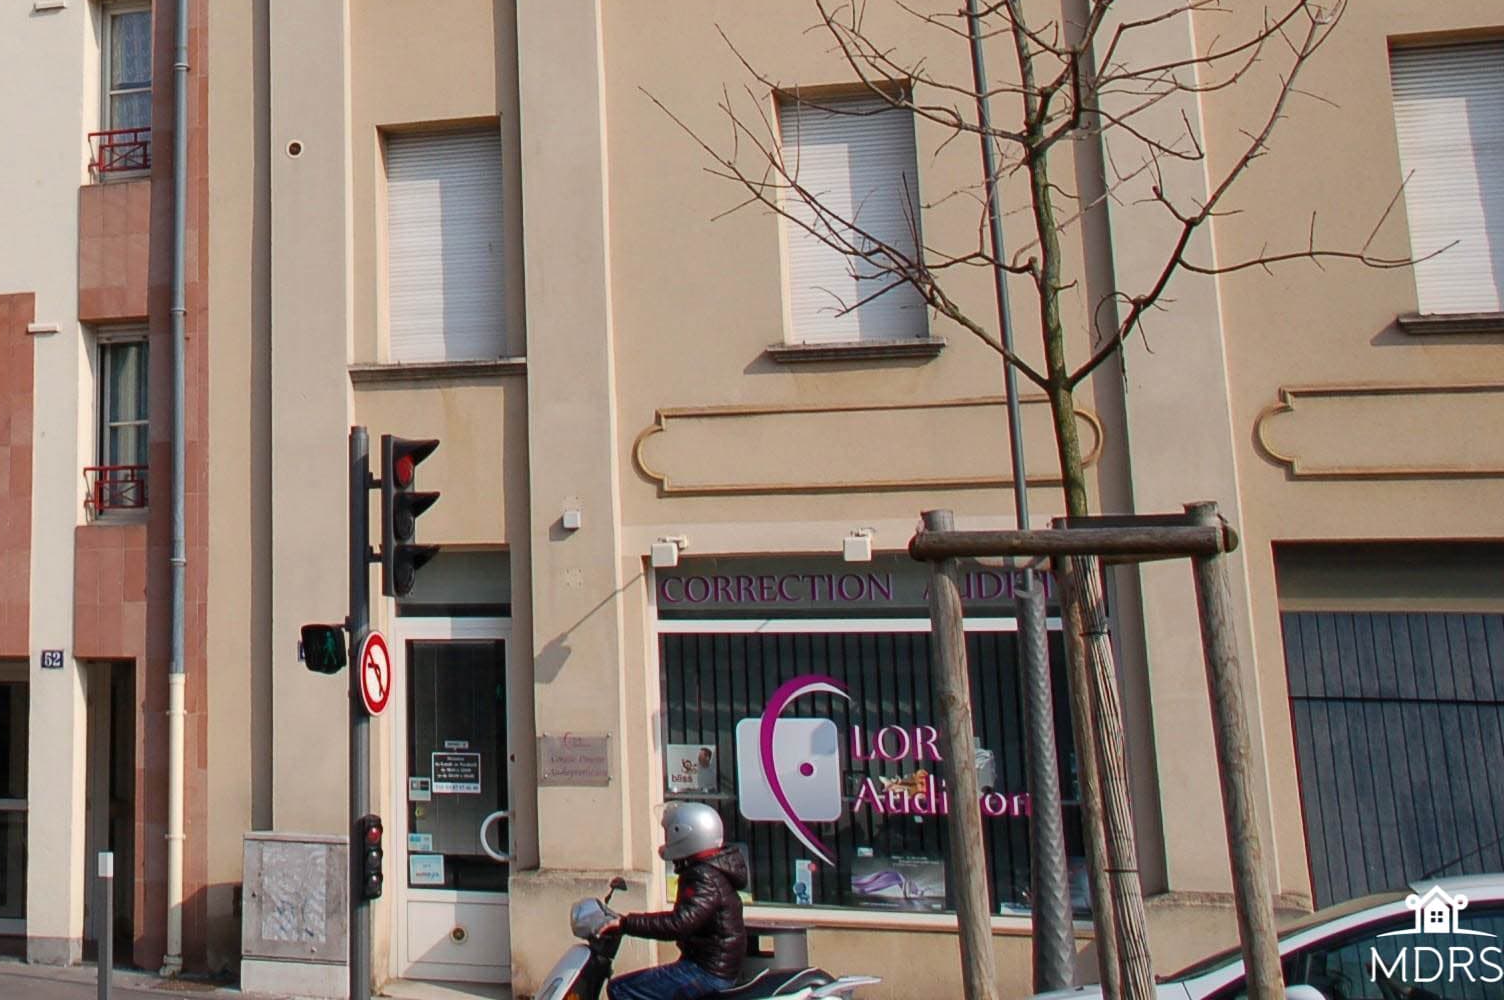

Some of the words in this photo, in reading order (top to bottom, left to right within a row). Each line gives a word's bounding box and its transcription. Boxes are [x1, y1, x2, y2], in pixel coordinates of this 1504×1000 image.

[660, 573, 893, 603] CORRECTION
[850, 724, 945, 761] LOR
[853, 773, 1033, 816] Audion
